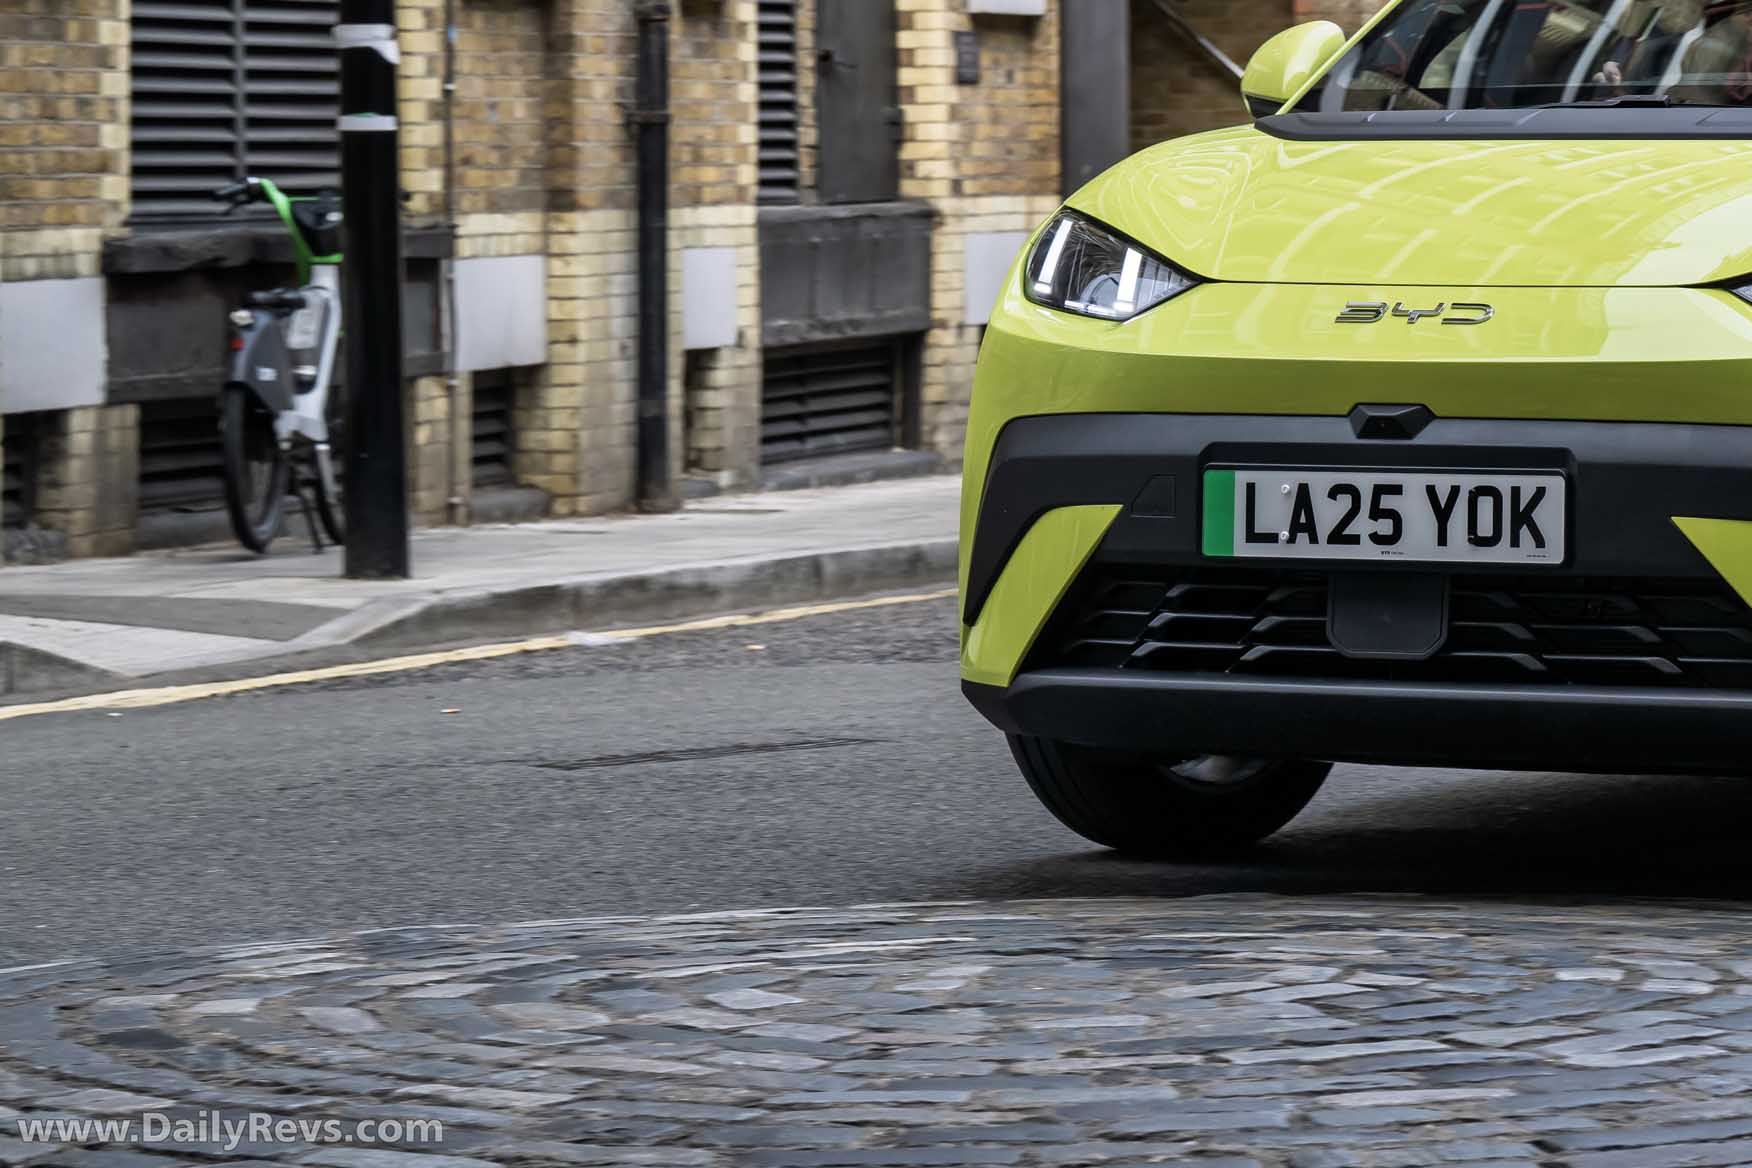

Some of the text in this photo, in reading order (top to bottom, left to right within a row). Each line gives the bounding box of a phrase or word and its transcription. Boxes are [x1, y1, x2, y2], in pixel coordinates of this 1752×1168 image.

[1335, 301, 1495, 325] BYD
[1245, 481, 1547, 549] LA25 YOK
